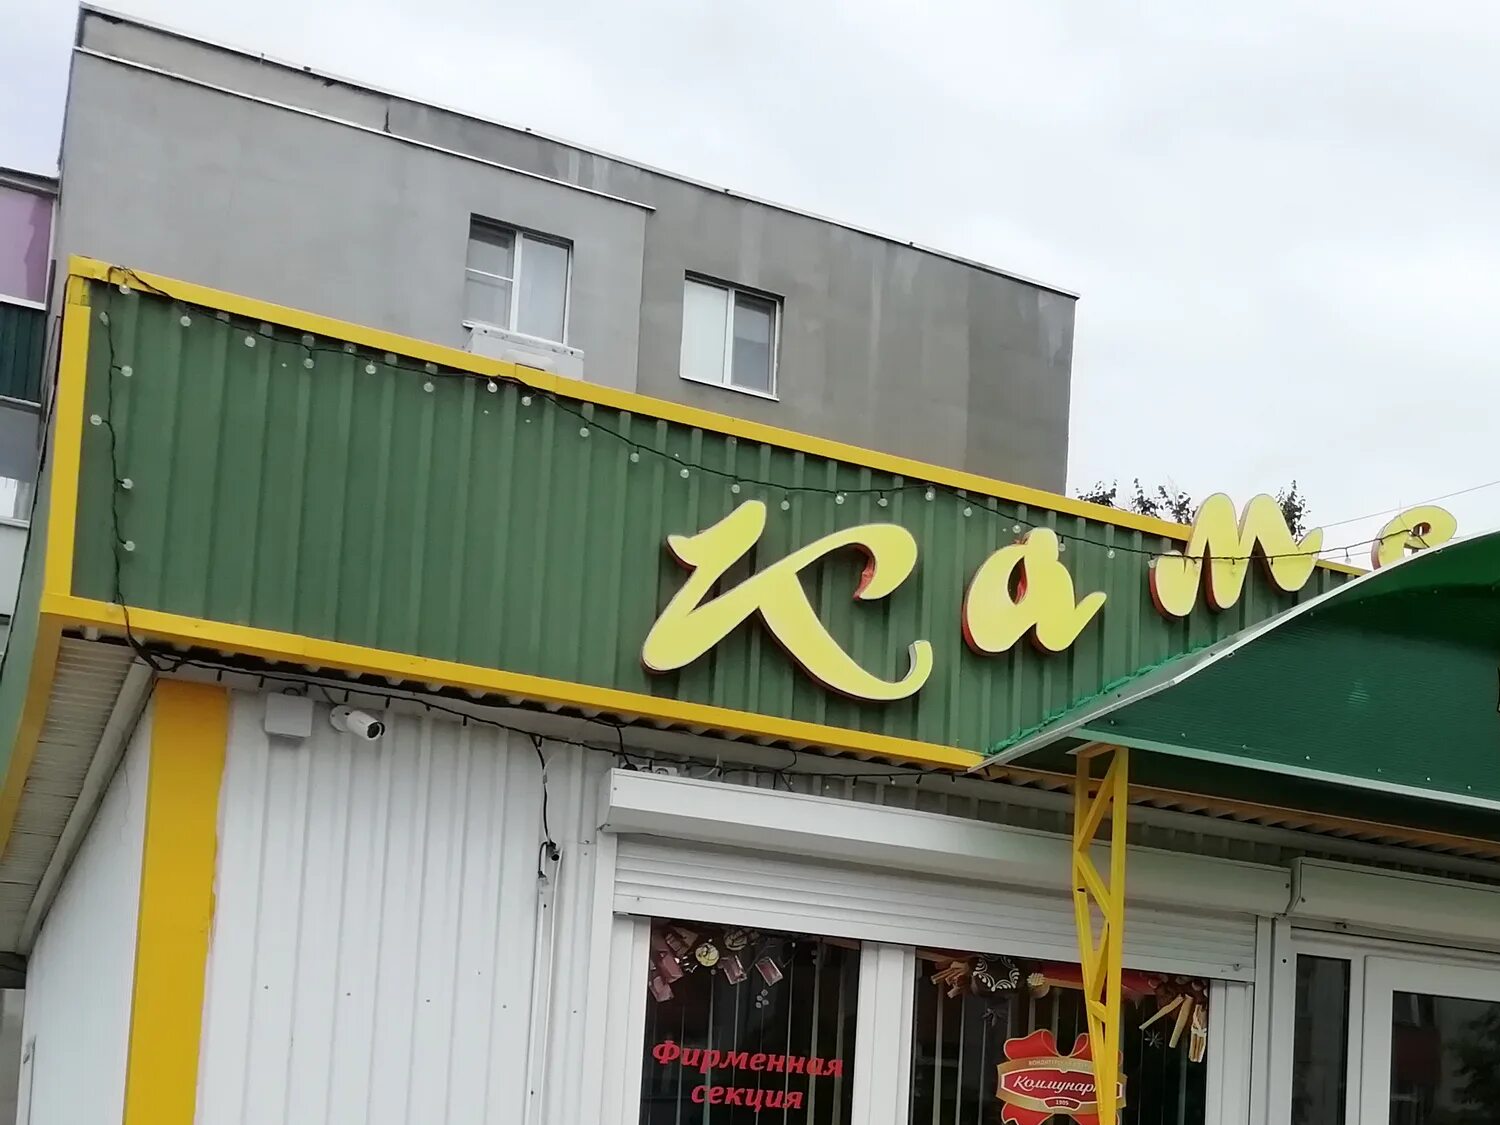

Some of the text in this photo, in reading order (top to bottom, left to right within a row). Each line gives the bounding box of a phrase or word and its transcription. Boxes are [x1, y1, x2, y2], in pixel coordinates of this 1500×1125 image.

[652, 1038, 844, 1078] Фирменная
[690, 1079, 804, 1113] секция
[1013, 1075, 1097, 1096] Коммунар
